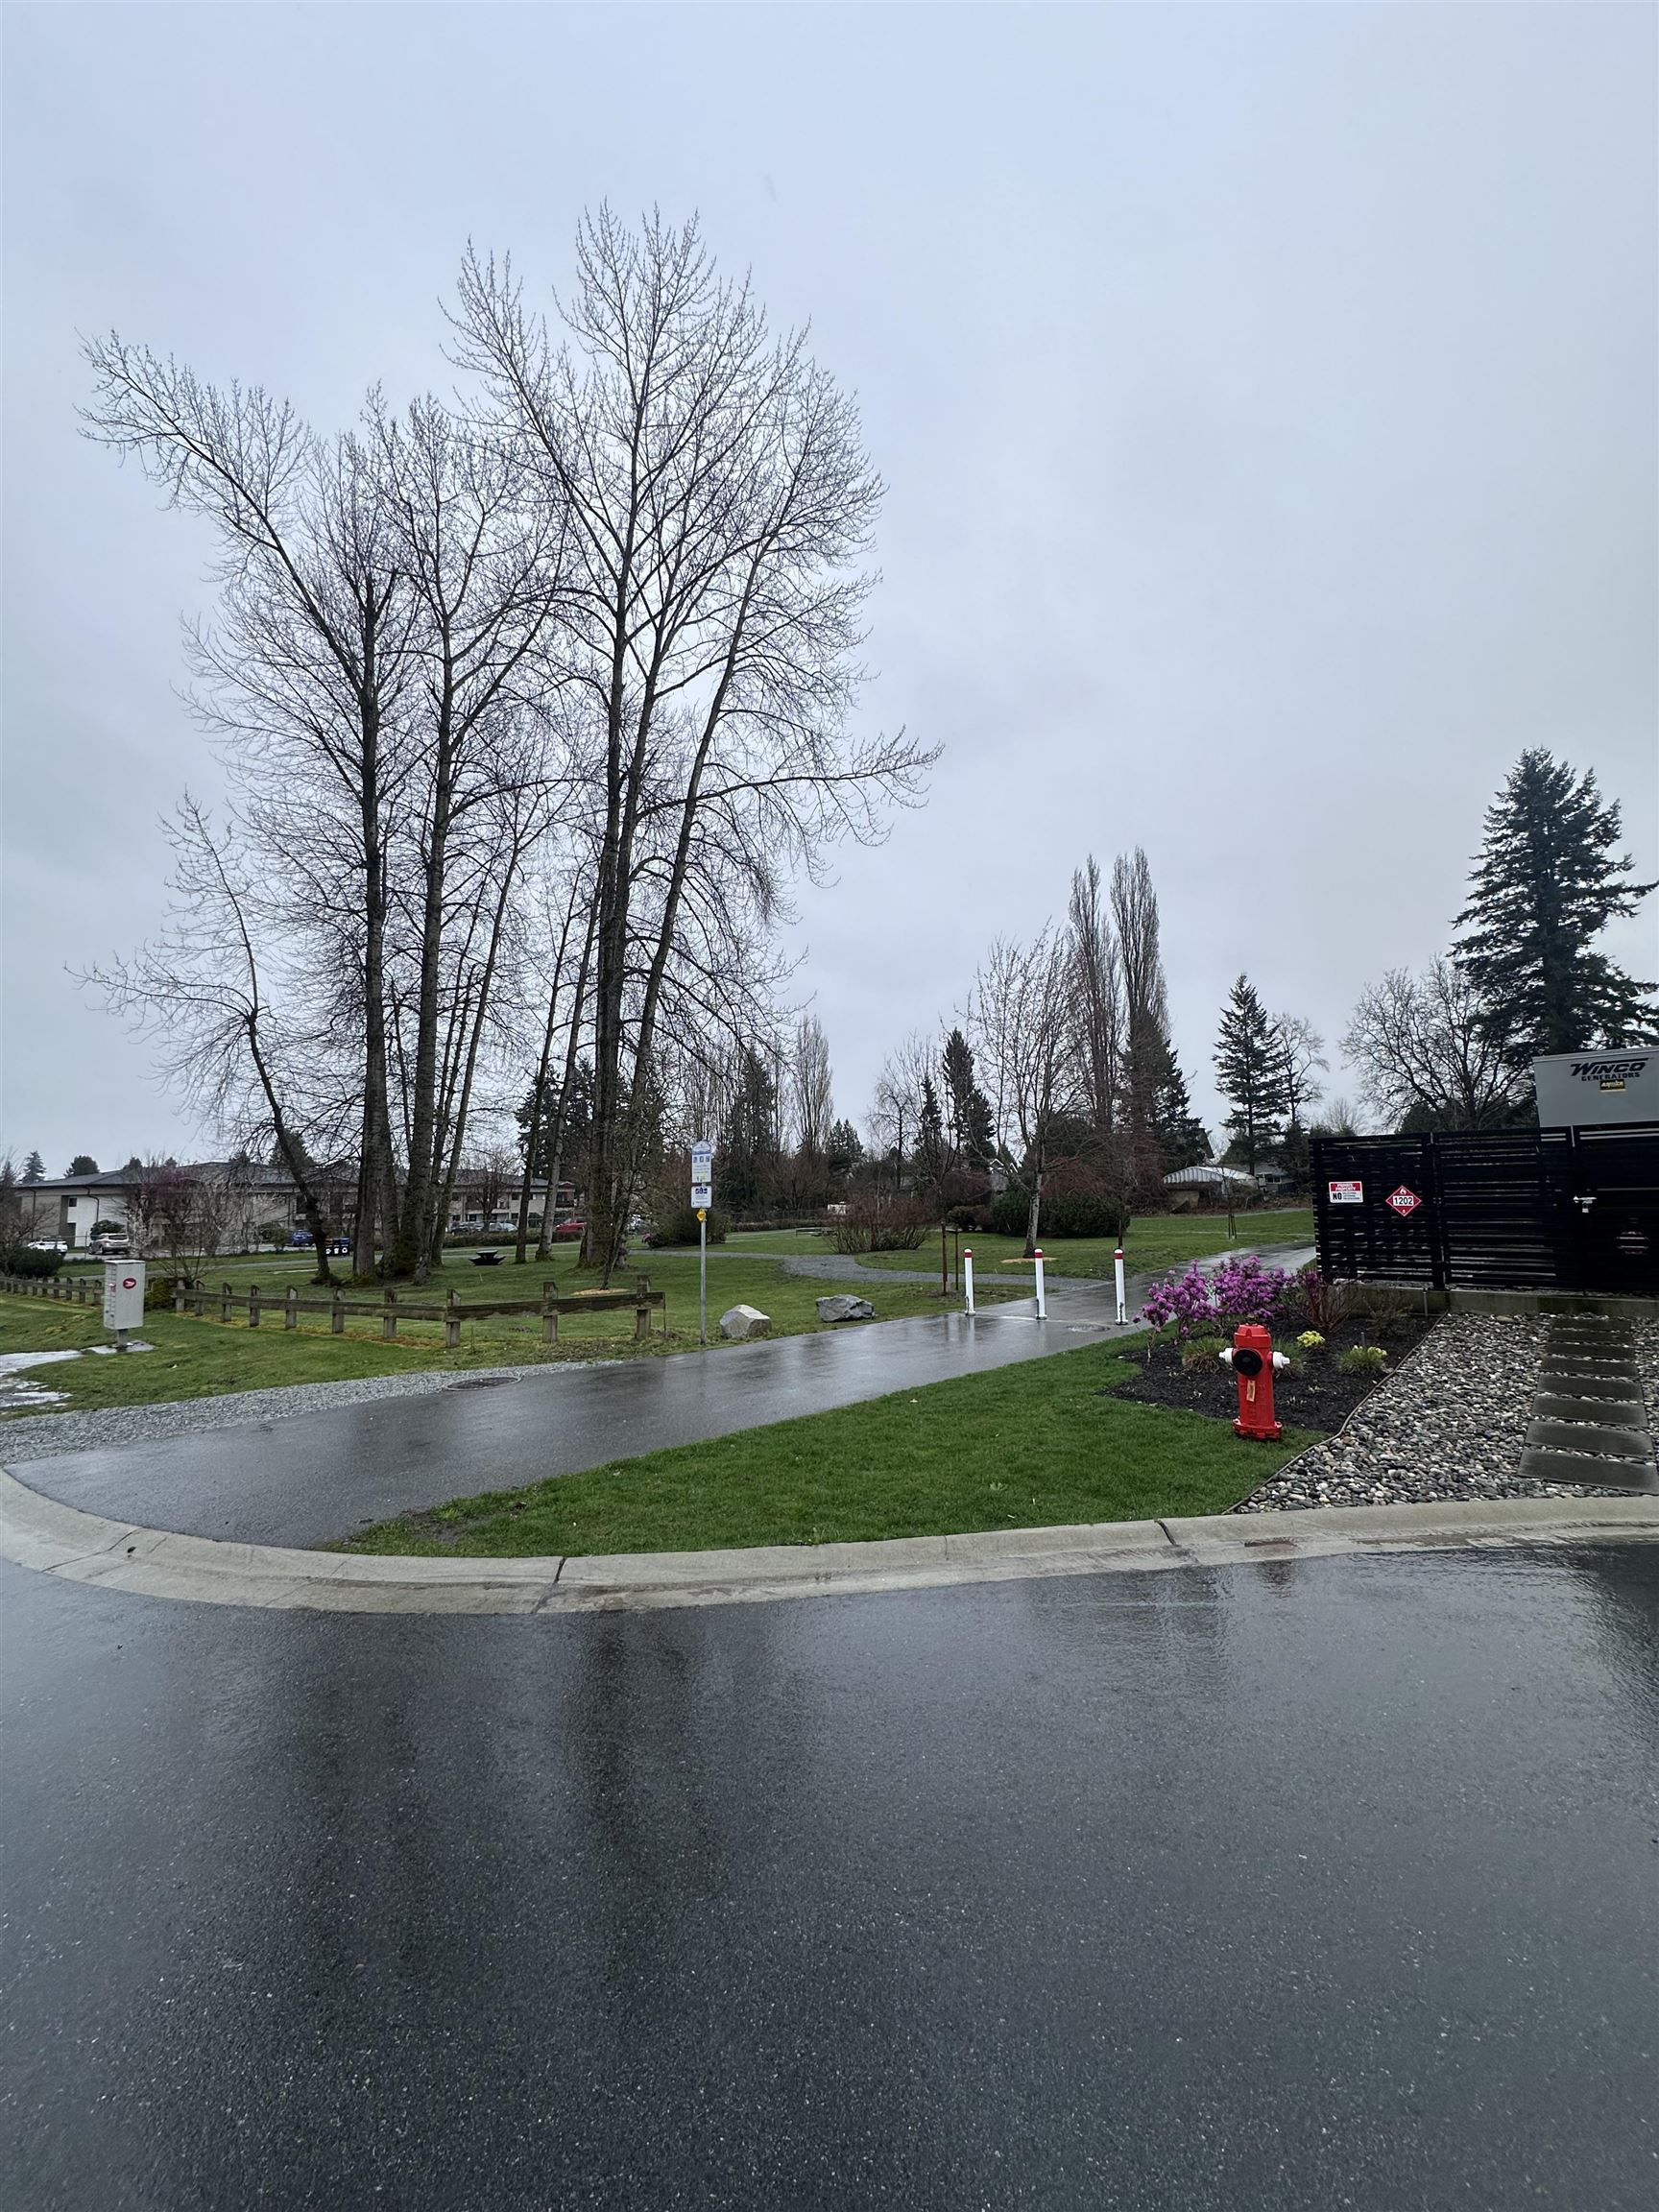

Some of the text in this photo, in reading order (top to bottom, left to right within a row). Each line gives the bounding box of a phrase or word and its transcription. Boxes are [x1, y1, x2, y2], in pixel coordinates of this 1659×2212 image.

[1570, 1059, 1647, 1076] WINCO
[1581, 1071, 1641, 1081] GENERATORS
[1394, 1196, 1413, 1205] 1202
